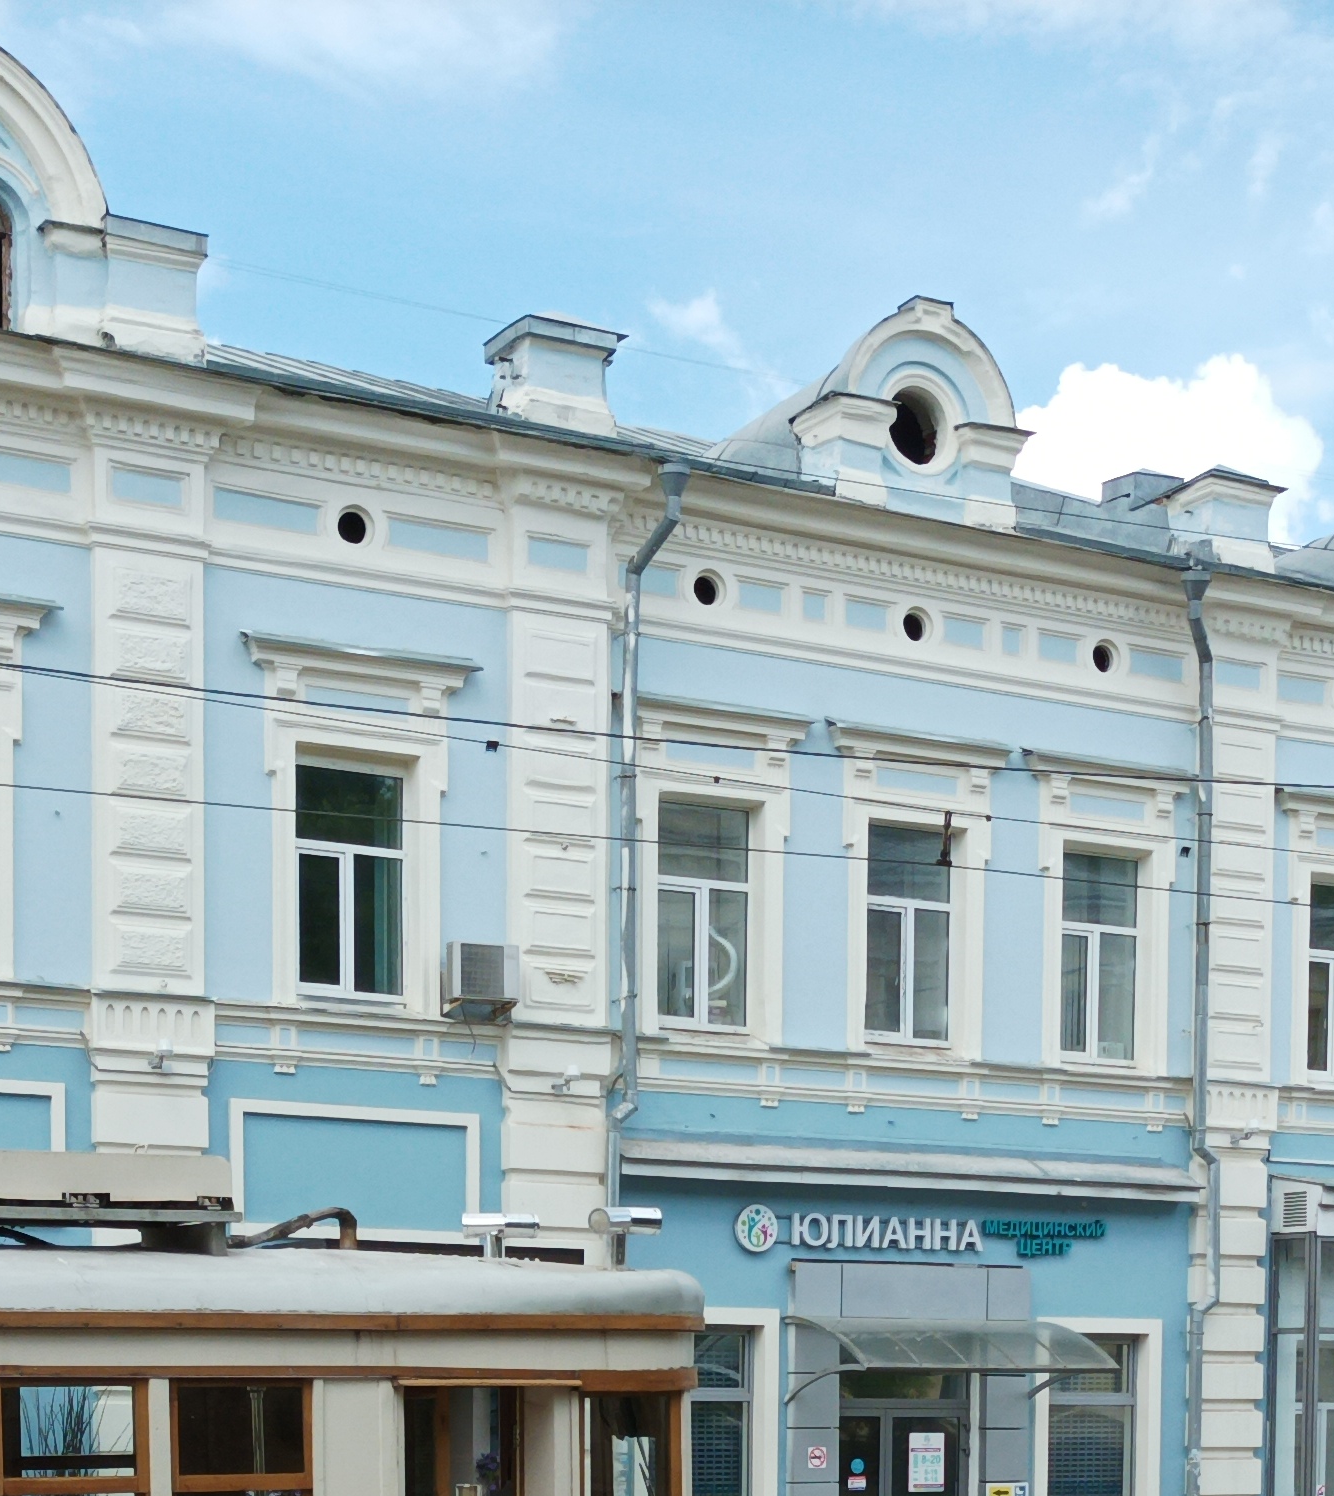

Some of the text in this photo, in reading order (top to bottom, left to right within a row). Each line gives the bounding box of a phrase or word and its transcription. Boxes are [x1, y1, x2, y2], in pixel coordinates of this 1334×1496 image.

[790, 1211, 984, 1252] ЮЛИАННА
[983, 1219, 1107, 1238] МЕДИЦИНСКИЙ
[1017, 1239, 1072, 1257] ЦЕНТР
